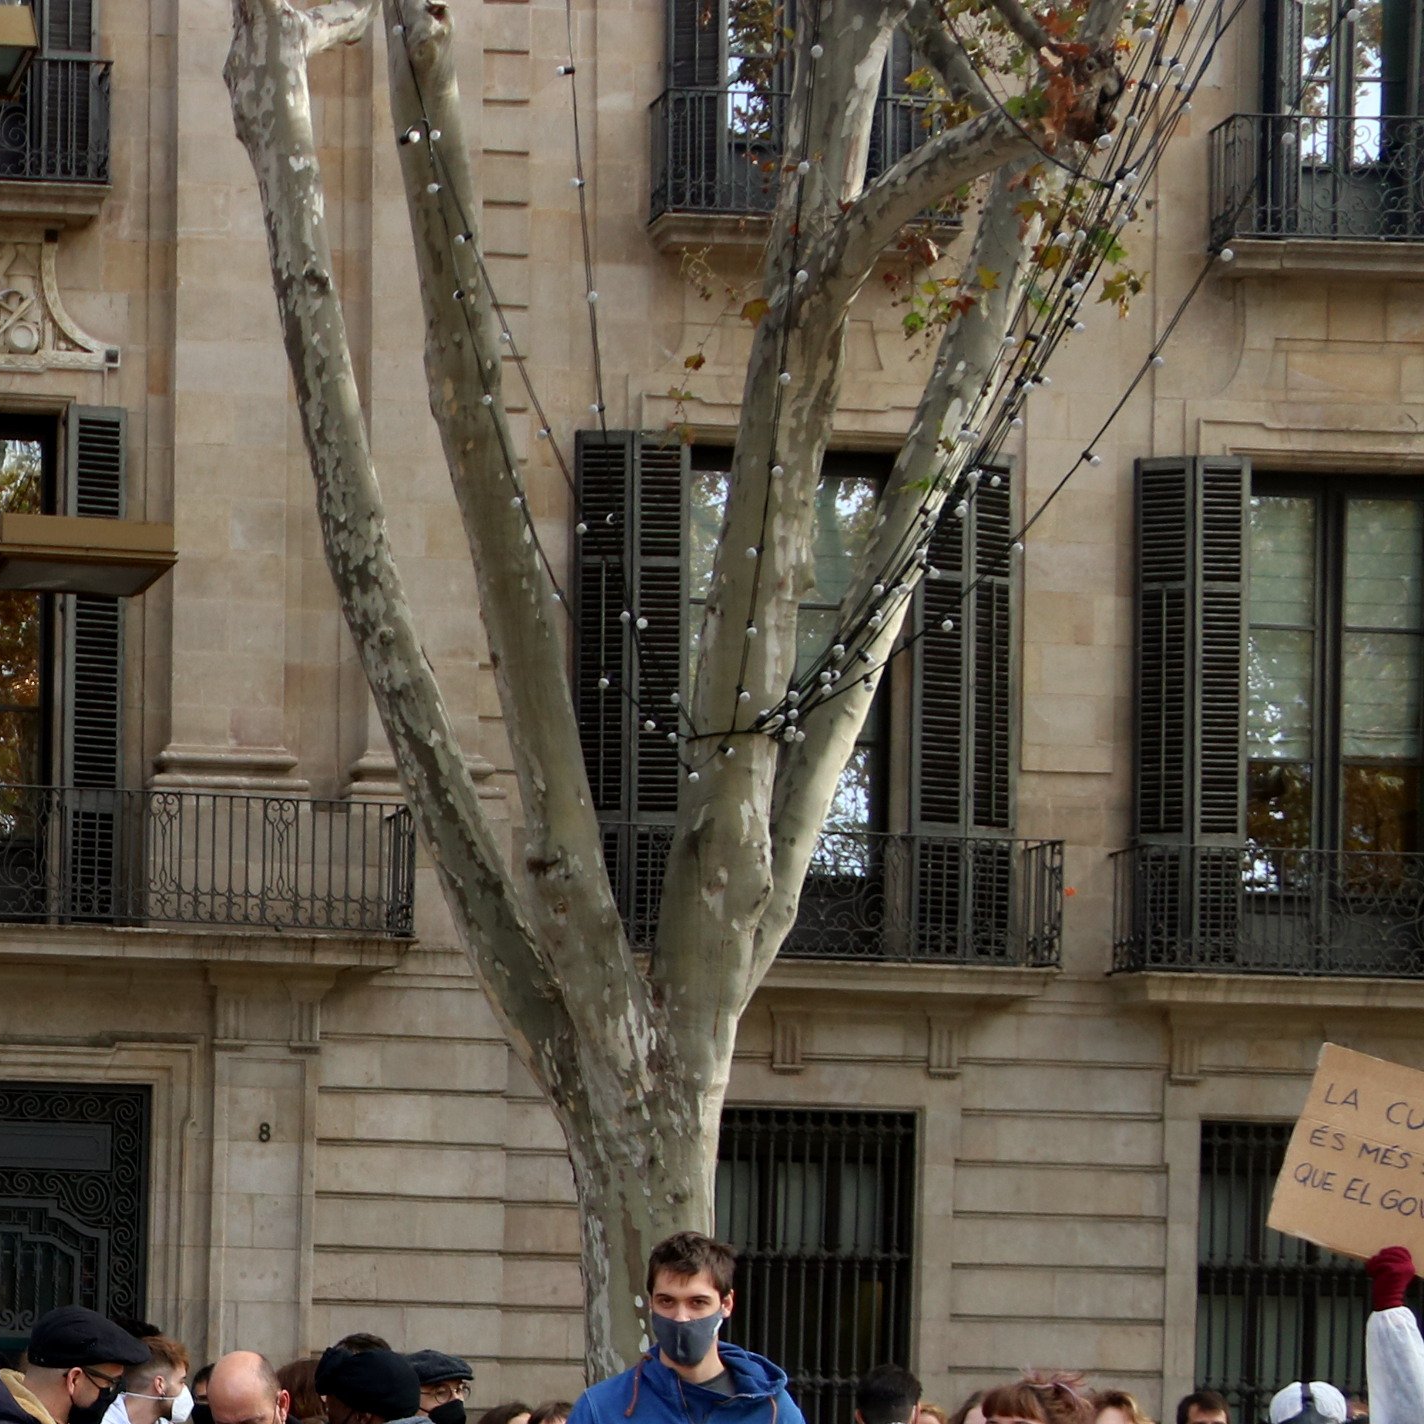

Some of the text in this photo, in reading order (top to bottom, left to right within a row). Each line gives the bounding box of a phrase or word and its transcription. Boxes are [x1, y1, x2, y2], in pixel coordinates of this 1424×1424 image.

[1324, 1083, 1359, 1110] LA
[1309, 1125, 1412, 1170] ÉS MÉS
[1293, 1162, 1337, 1191] QUE
[1343, 1178, 1372, 1206] EL
